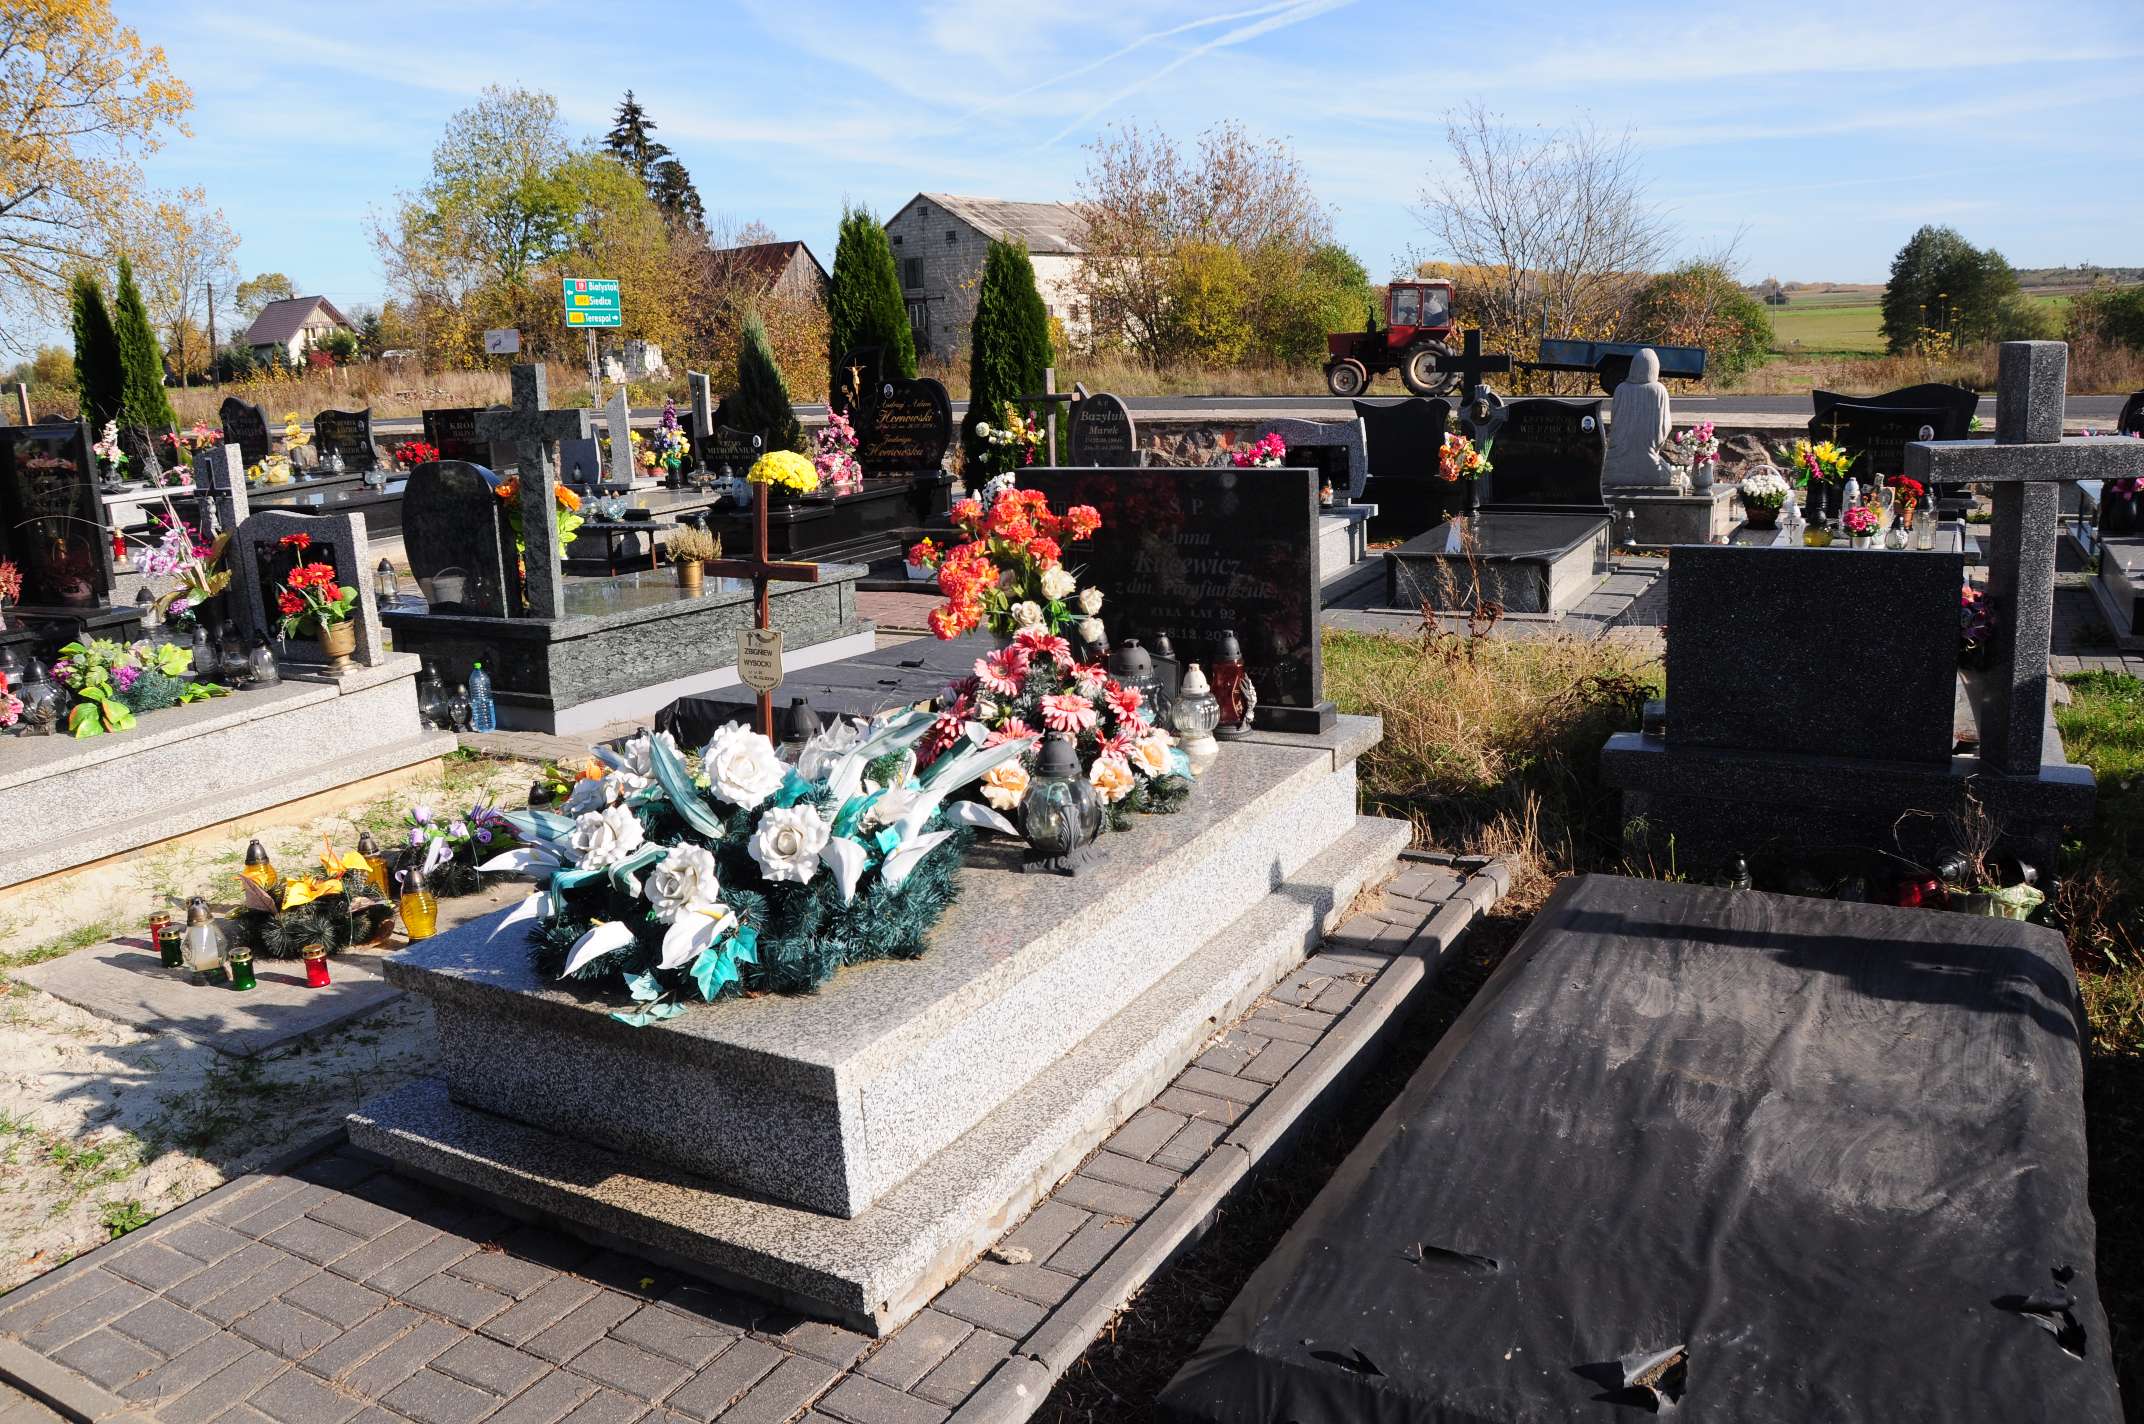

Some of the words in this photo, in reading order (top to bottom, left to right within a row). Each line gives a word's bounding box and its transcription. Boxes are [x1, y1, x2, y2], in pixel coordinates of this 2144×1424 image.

[588, 281, 618, 292] Białystok
[589, 296, 612, 305] Siedlce
[585, 313, 612, 324] Terespol
[1080, 411, 1125, 422] Bazyluk
[1089, 425, 1119, 434] Marek
[1168, 524, 1211, 545] Anna
[1218, 608, 1236, 620] 92
[743, 647, 773, 657] ZBIGNIEW
[743, 659, 772, 668] WYSOCKI
